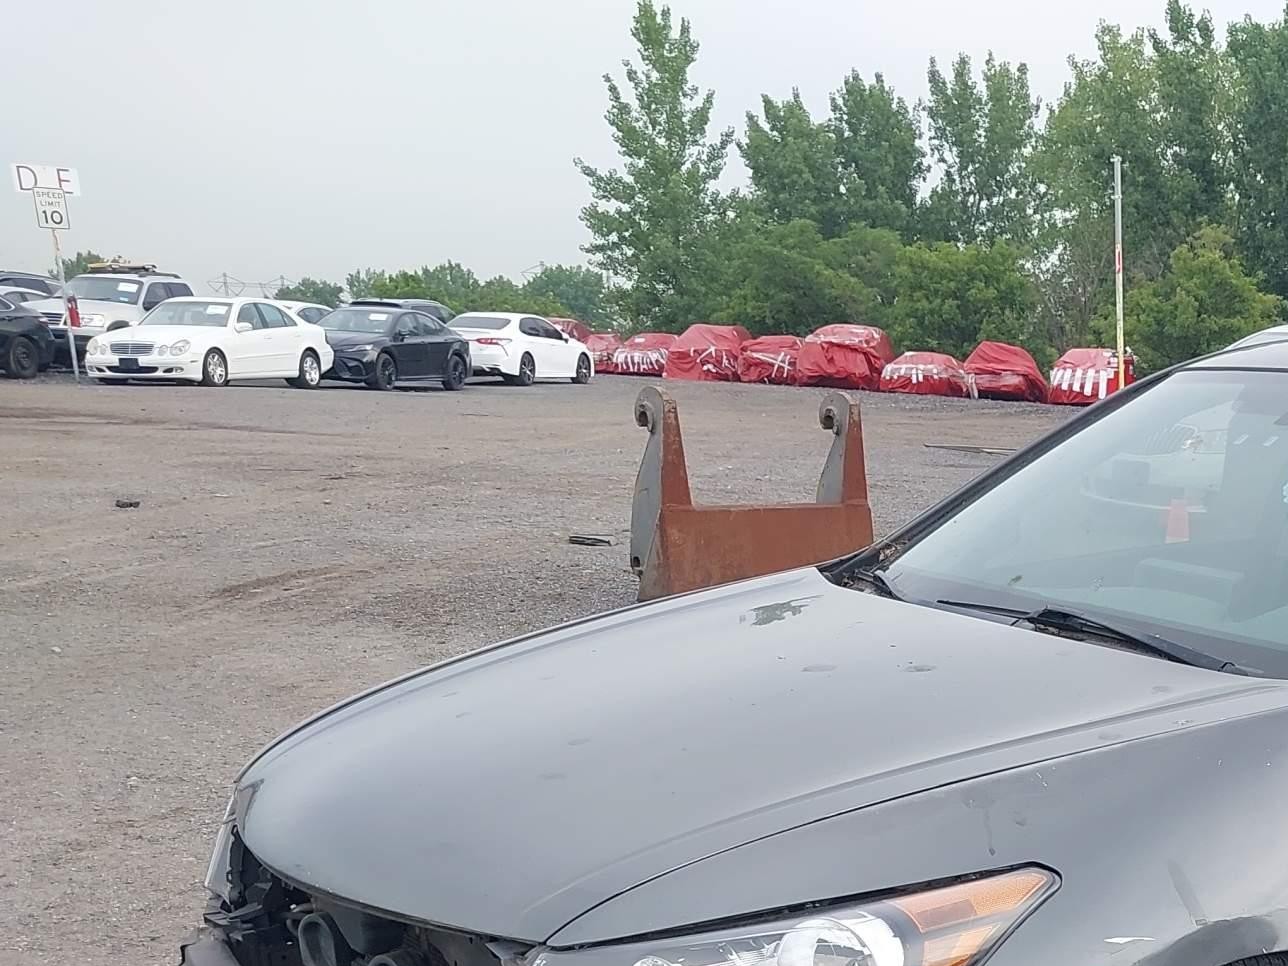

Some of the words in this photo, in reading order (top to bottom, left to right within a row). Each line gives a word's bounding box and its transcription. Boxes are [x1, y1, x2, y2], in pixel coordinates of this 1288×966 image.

[16, 165, 38, 191] D
[36, 191, 63, 199] SPEED
[40, 200, 61, 208] LIMIT
[42, 210, 63, 225] 10
